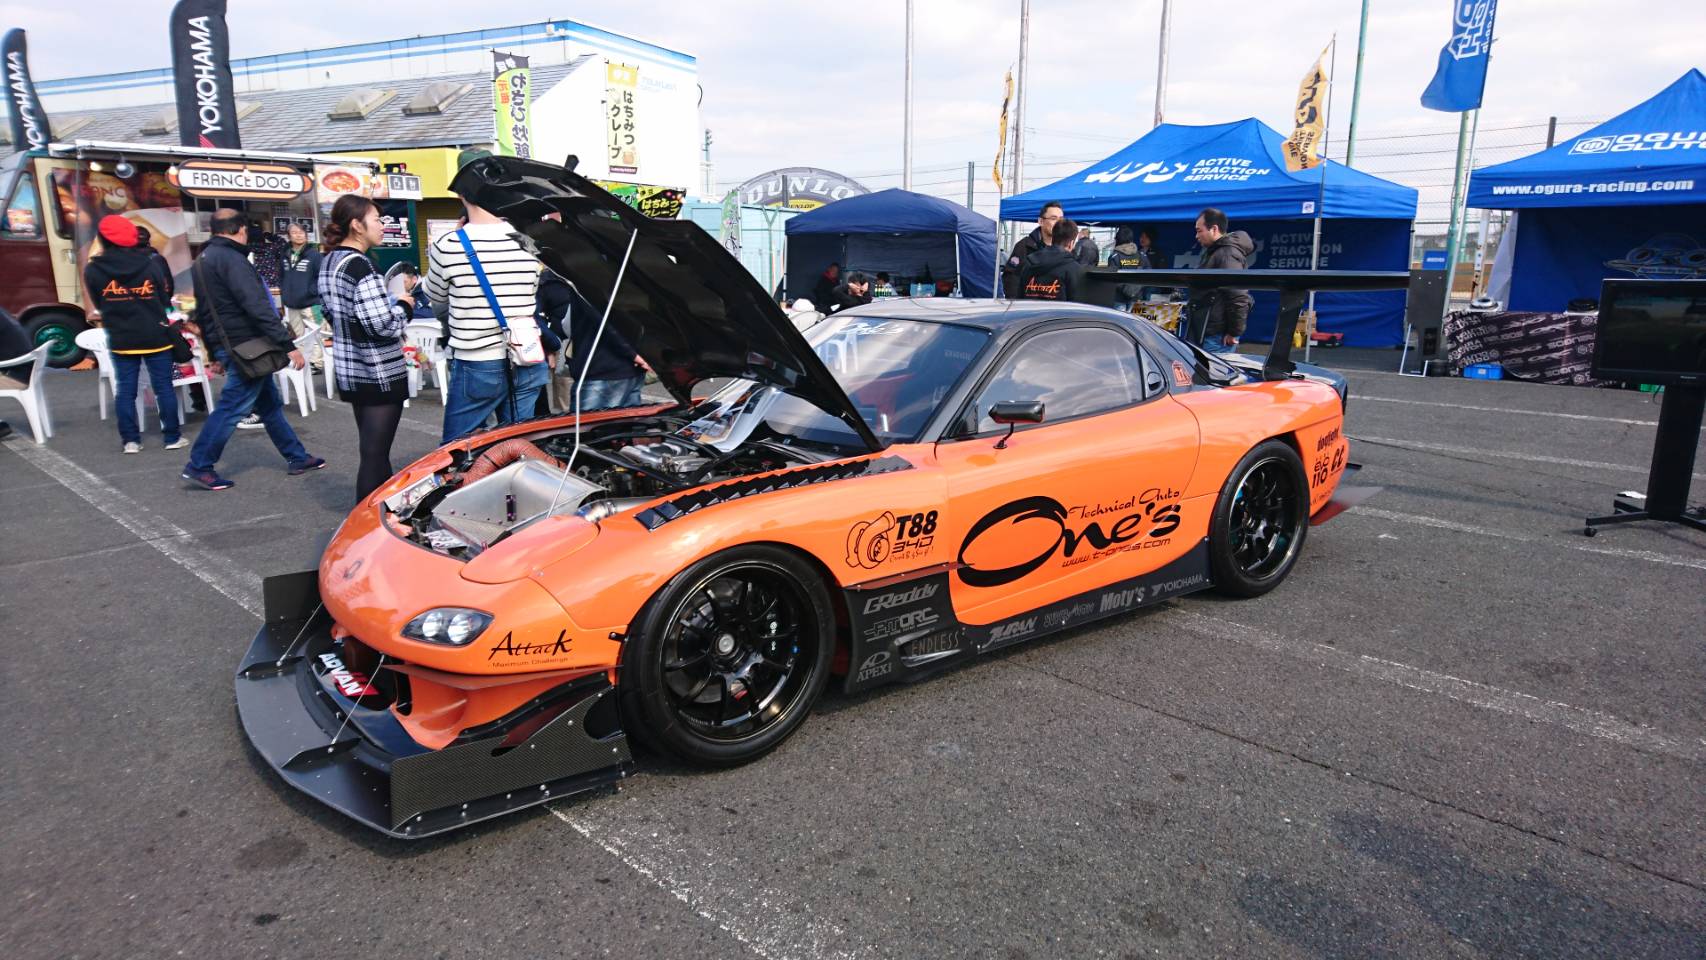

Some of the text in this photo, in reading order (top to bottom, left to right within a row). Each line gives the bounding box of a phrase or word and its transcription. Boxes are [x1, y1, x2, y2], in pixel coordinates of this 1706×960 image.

[188, 15, 222, 135] YOKOHAMA
[622, 90, 636, 146] はちみつ
[610, 104, 622, 160] クレープ
[1190, 167, 1270, 176] TRACTION
[1194, 157, 1253, 168] ACTIVE
[192, 172, 291, 189] FRANCE DOG
[746, 176, 856, 205] DUNLO
[1183, 173, 1251, 182] SERVICE
[1492, 179, 1695, 195] www.ogura-racing.com
[1269, 243, 1342, 256] TRACTON
[1270, 233, 1318, 244] ACTIV
[1067, 496, 1136, 519] Technical
[896, 510, 938, 540] T88
[956, 495, 1182, 588] One's
[1163, 573, 1203, 592] YOKOHAMA
[863, 583, 940, 615] GReddy
[1100, 587, 1145, 612] Moty's
[487, 629, 573, 661] Attack
[911, 630, 960, 657] ENDLESS
[318, 653, 364, 696] ADVAN
